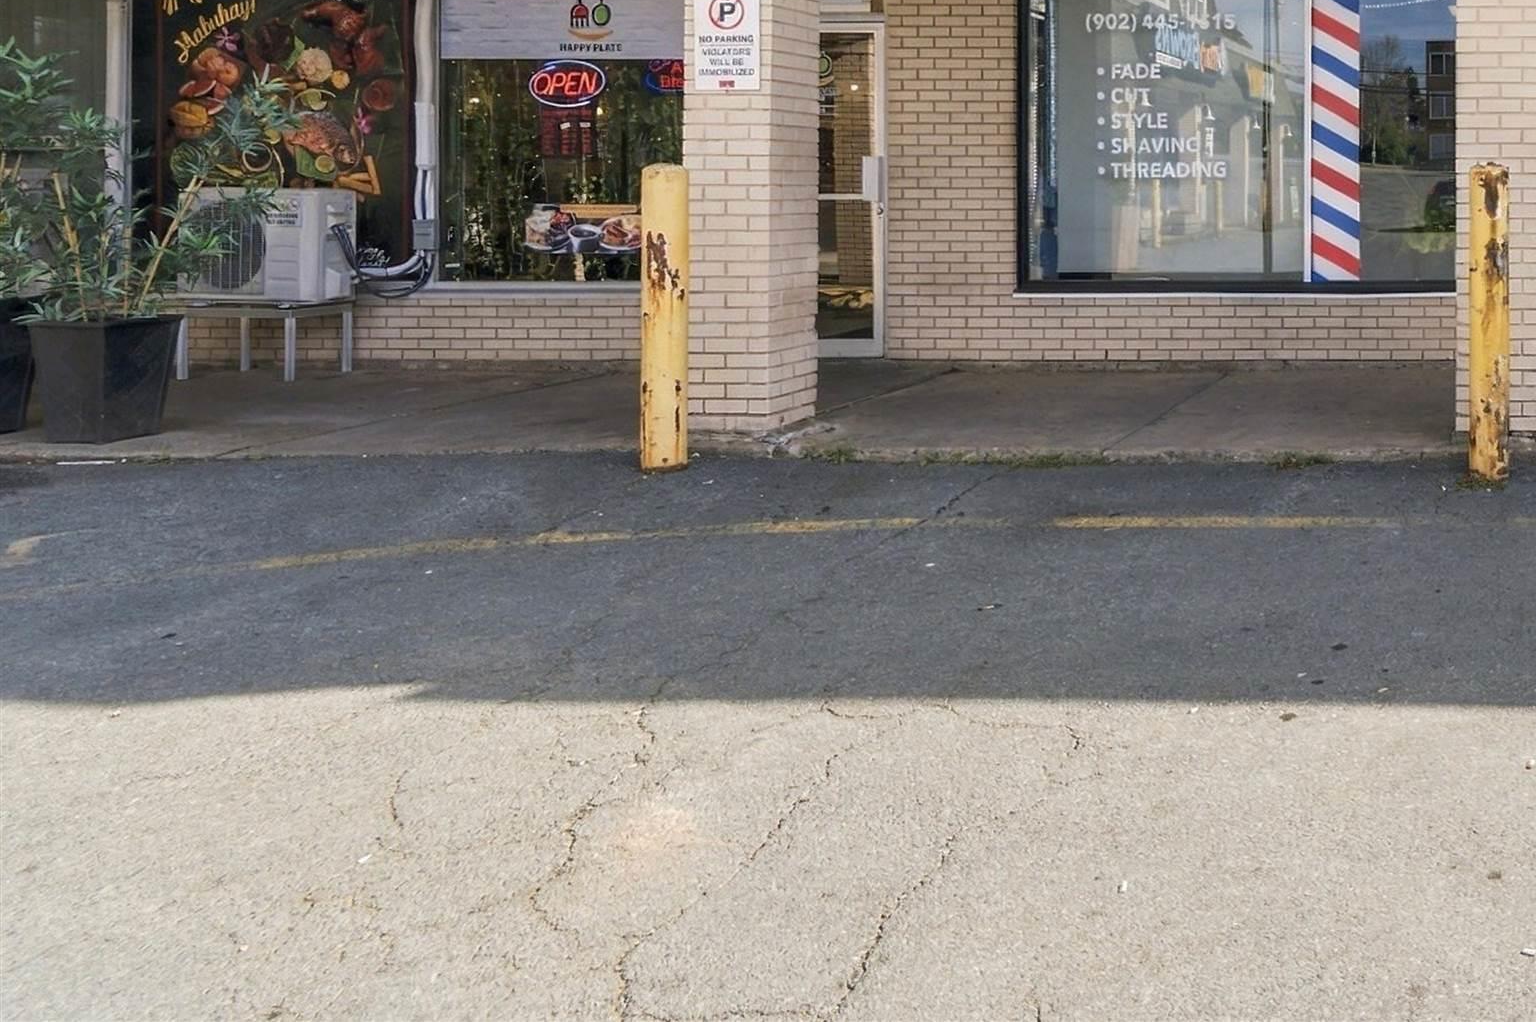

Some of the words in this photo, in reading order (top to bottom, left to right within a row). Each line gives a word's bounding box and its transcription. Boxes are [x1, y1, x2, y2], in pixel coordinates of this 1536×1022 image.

[1085, 13, 1137, 32] (902)
[698, 35, 712, 43] NO
[715, 35, 754, 43] PARKING
[560, 43, 592, 52] HAPPY
[593, 43, 623, 52] PLATE
[702, 48, 751, 56] VIOLATORS
[709, 58, 730, 66] WILL
[732, 58, 744, 66] BE
[698, 68, 755, 76] IMMOBILIZED
[1111, 63, 1161, 79] FADE
[532, 72, 598, 96] OPEN
[1111, 88, 1151, 104] CUT
[1111, 112, 1168, 129] STYLE
[1111, 137, 1200, 154] SHAVING
[1111, 161, 1227, 178] THREADING
